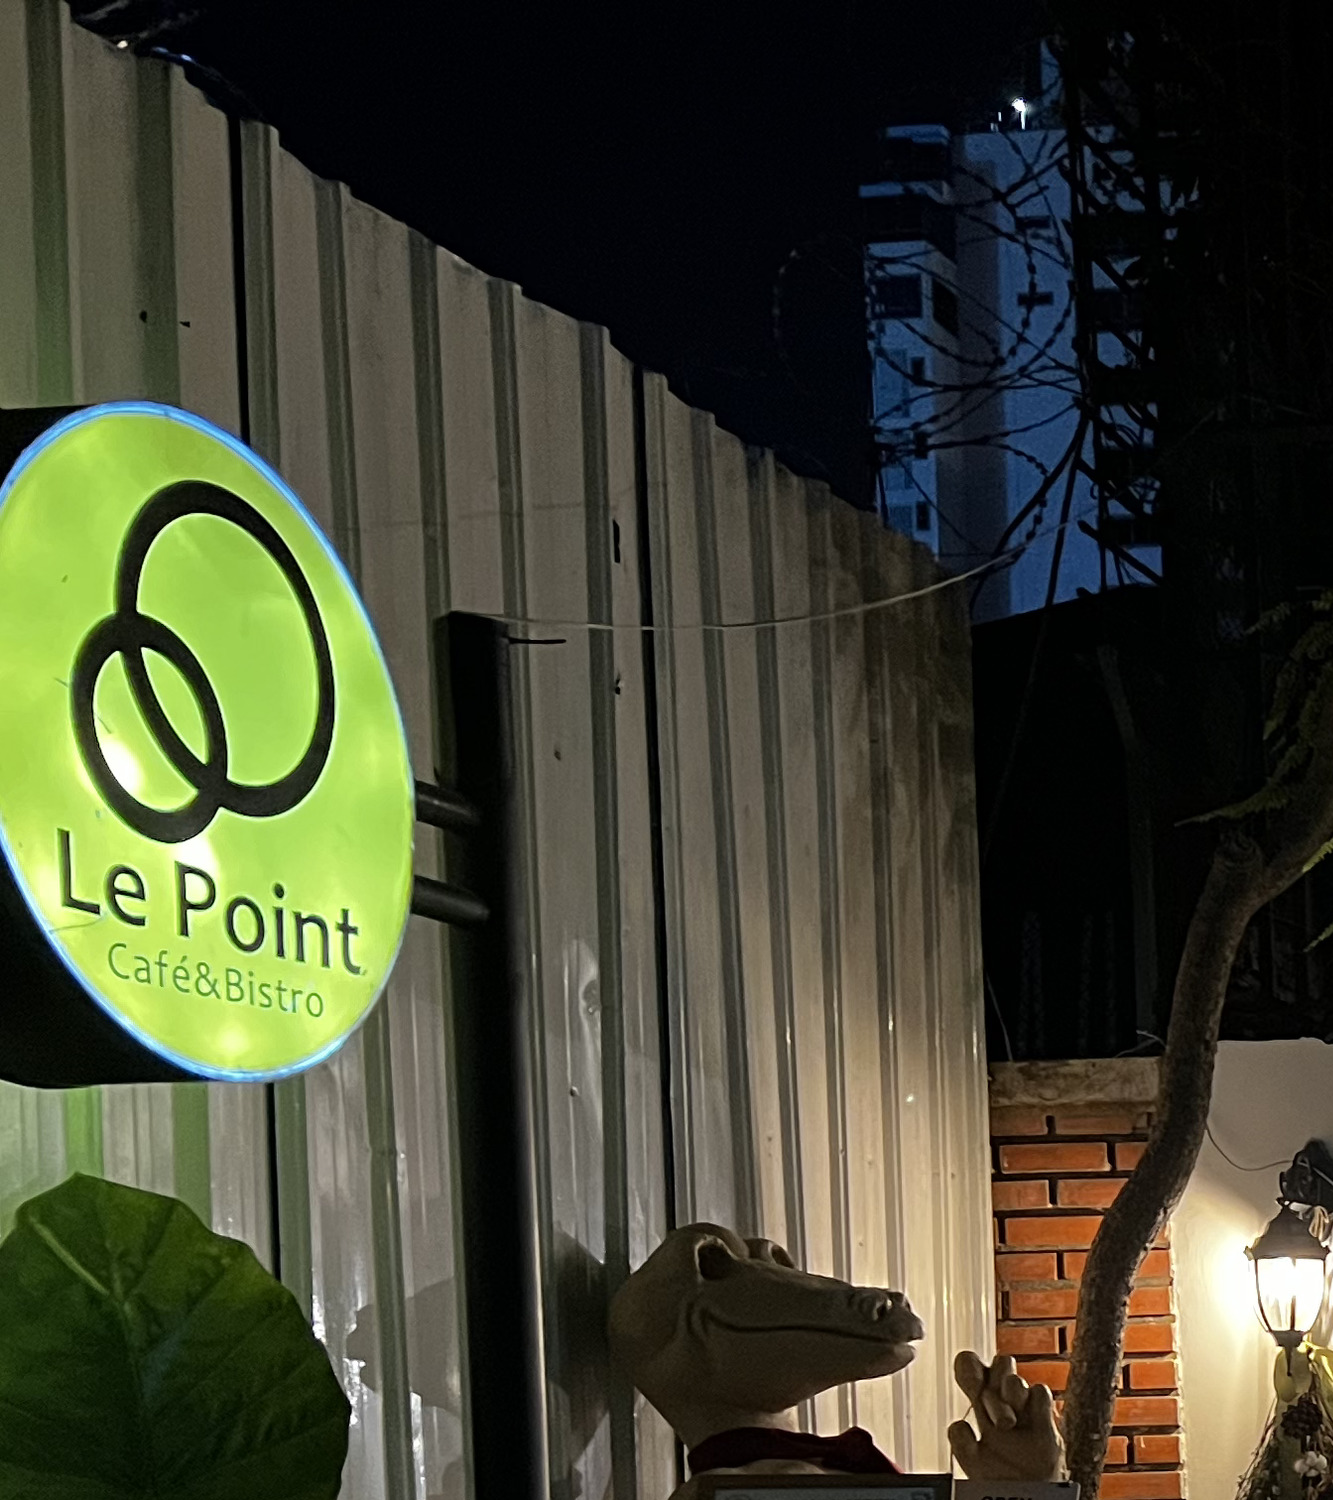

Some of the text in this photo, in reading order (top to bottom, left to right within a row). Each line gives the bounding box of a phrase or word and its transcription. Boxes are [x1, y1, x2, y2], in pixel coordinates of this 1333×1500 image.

[57, 828, 362, 976] Le Point
[107, 942, 325, 1019] Café&Bistro
